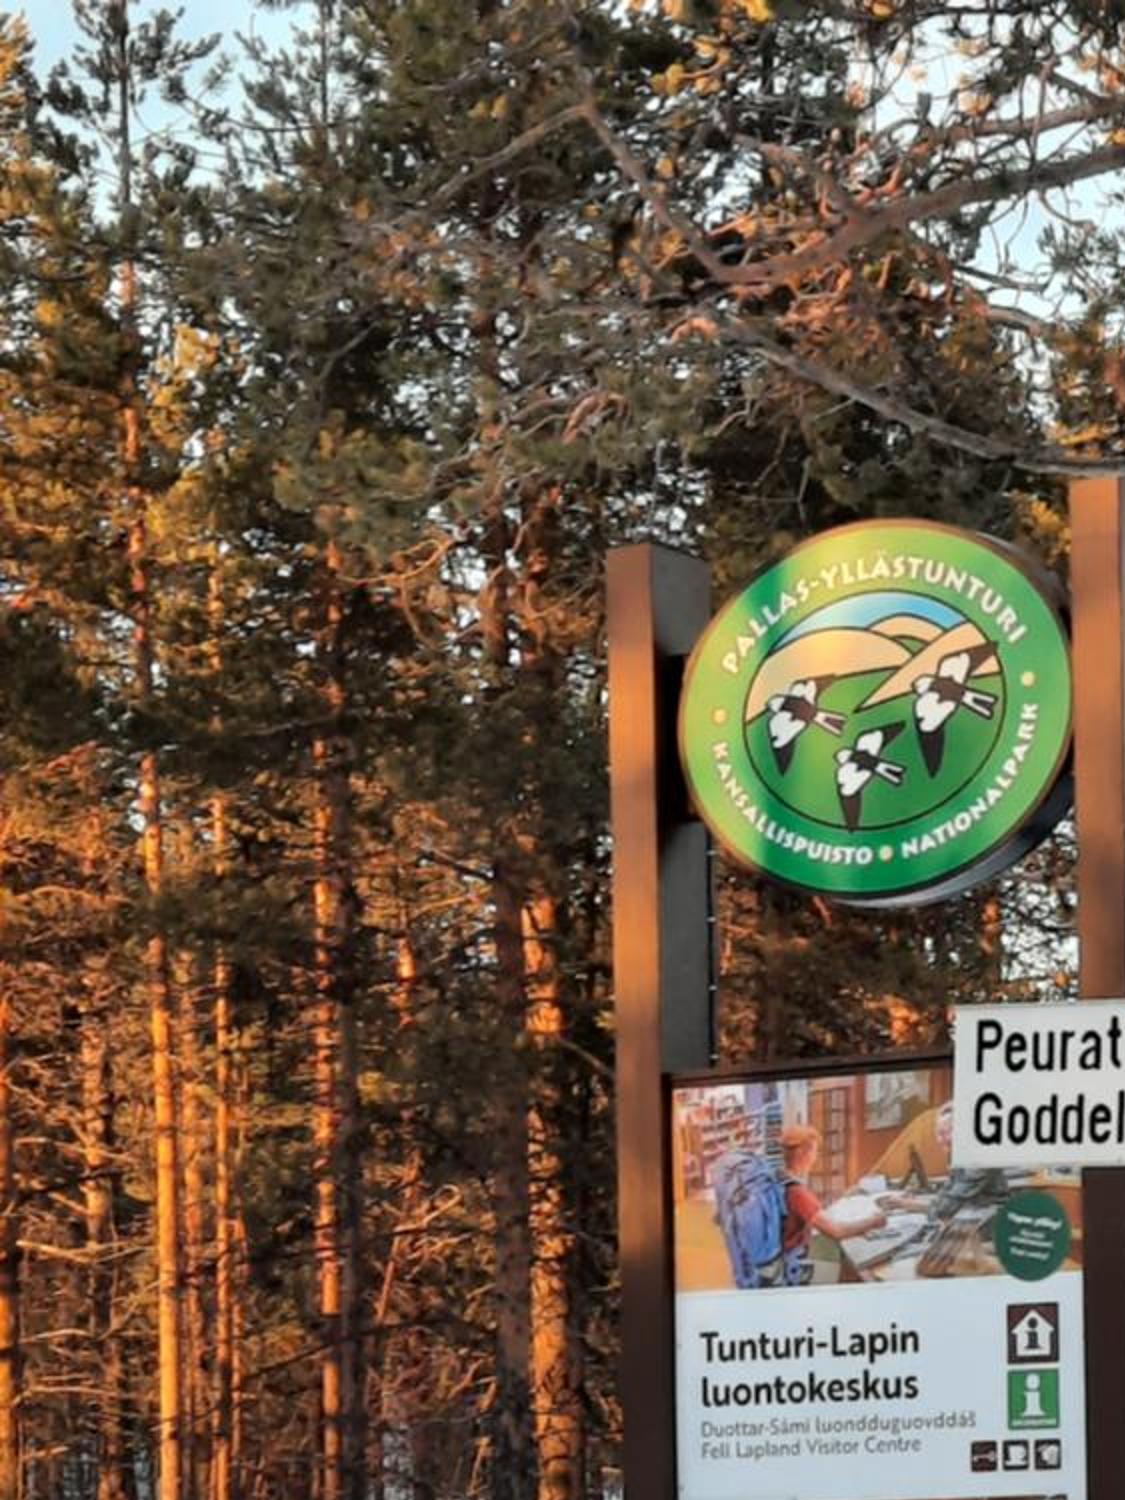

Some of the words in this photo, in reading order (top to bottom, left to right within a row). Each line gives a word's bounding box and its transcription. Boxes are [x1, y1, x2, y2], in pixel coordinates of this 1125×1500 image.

[722, 551, 1029, 674] PALLAS-YLLÄSTUNTURI
[712, 742, 873, 865] KANSALLISPUISTO
[901, 703, 1039, 859] NATIONALPARK
[700, 1323, 920, 1364] Tunturi-Lapin
[701, 1370, 919, 1408] luontokeskus
[701, 1441, 731, 1459] Fell
[735, 1438, 801, 1462] Lapland
[806, 1438, 859, 1456] Visitor
[863, 1436, 922, 1454] Centre
